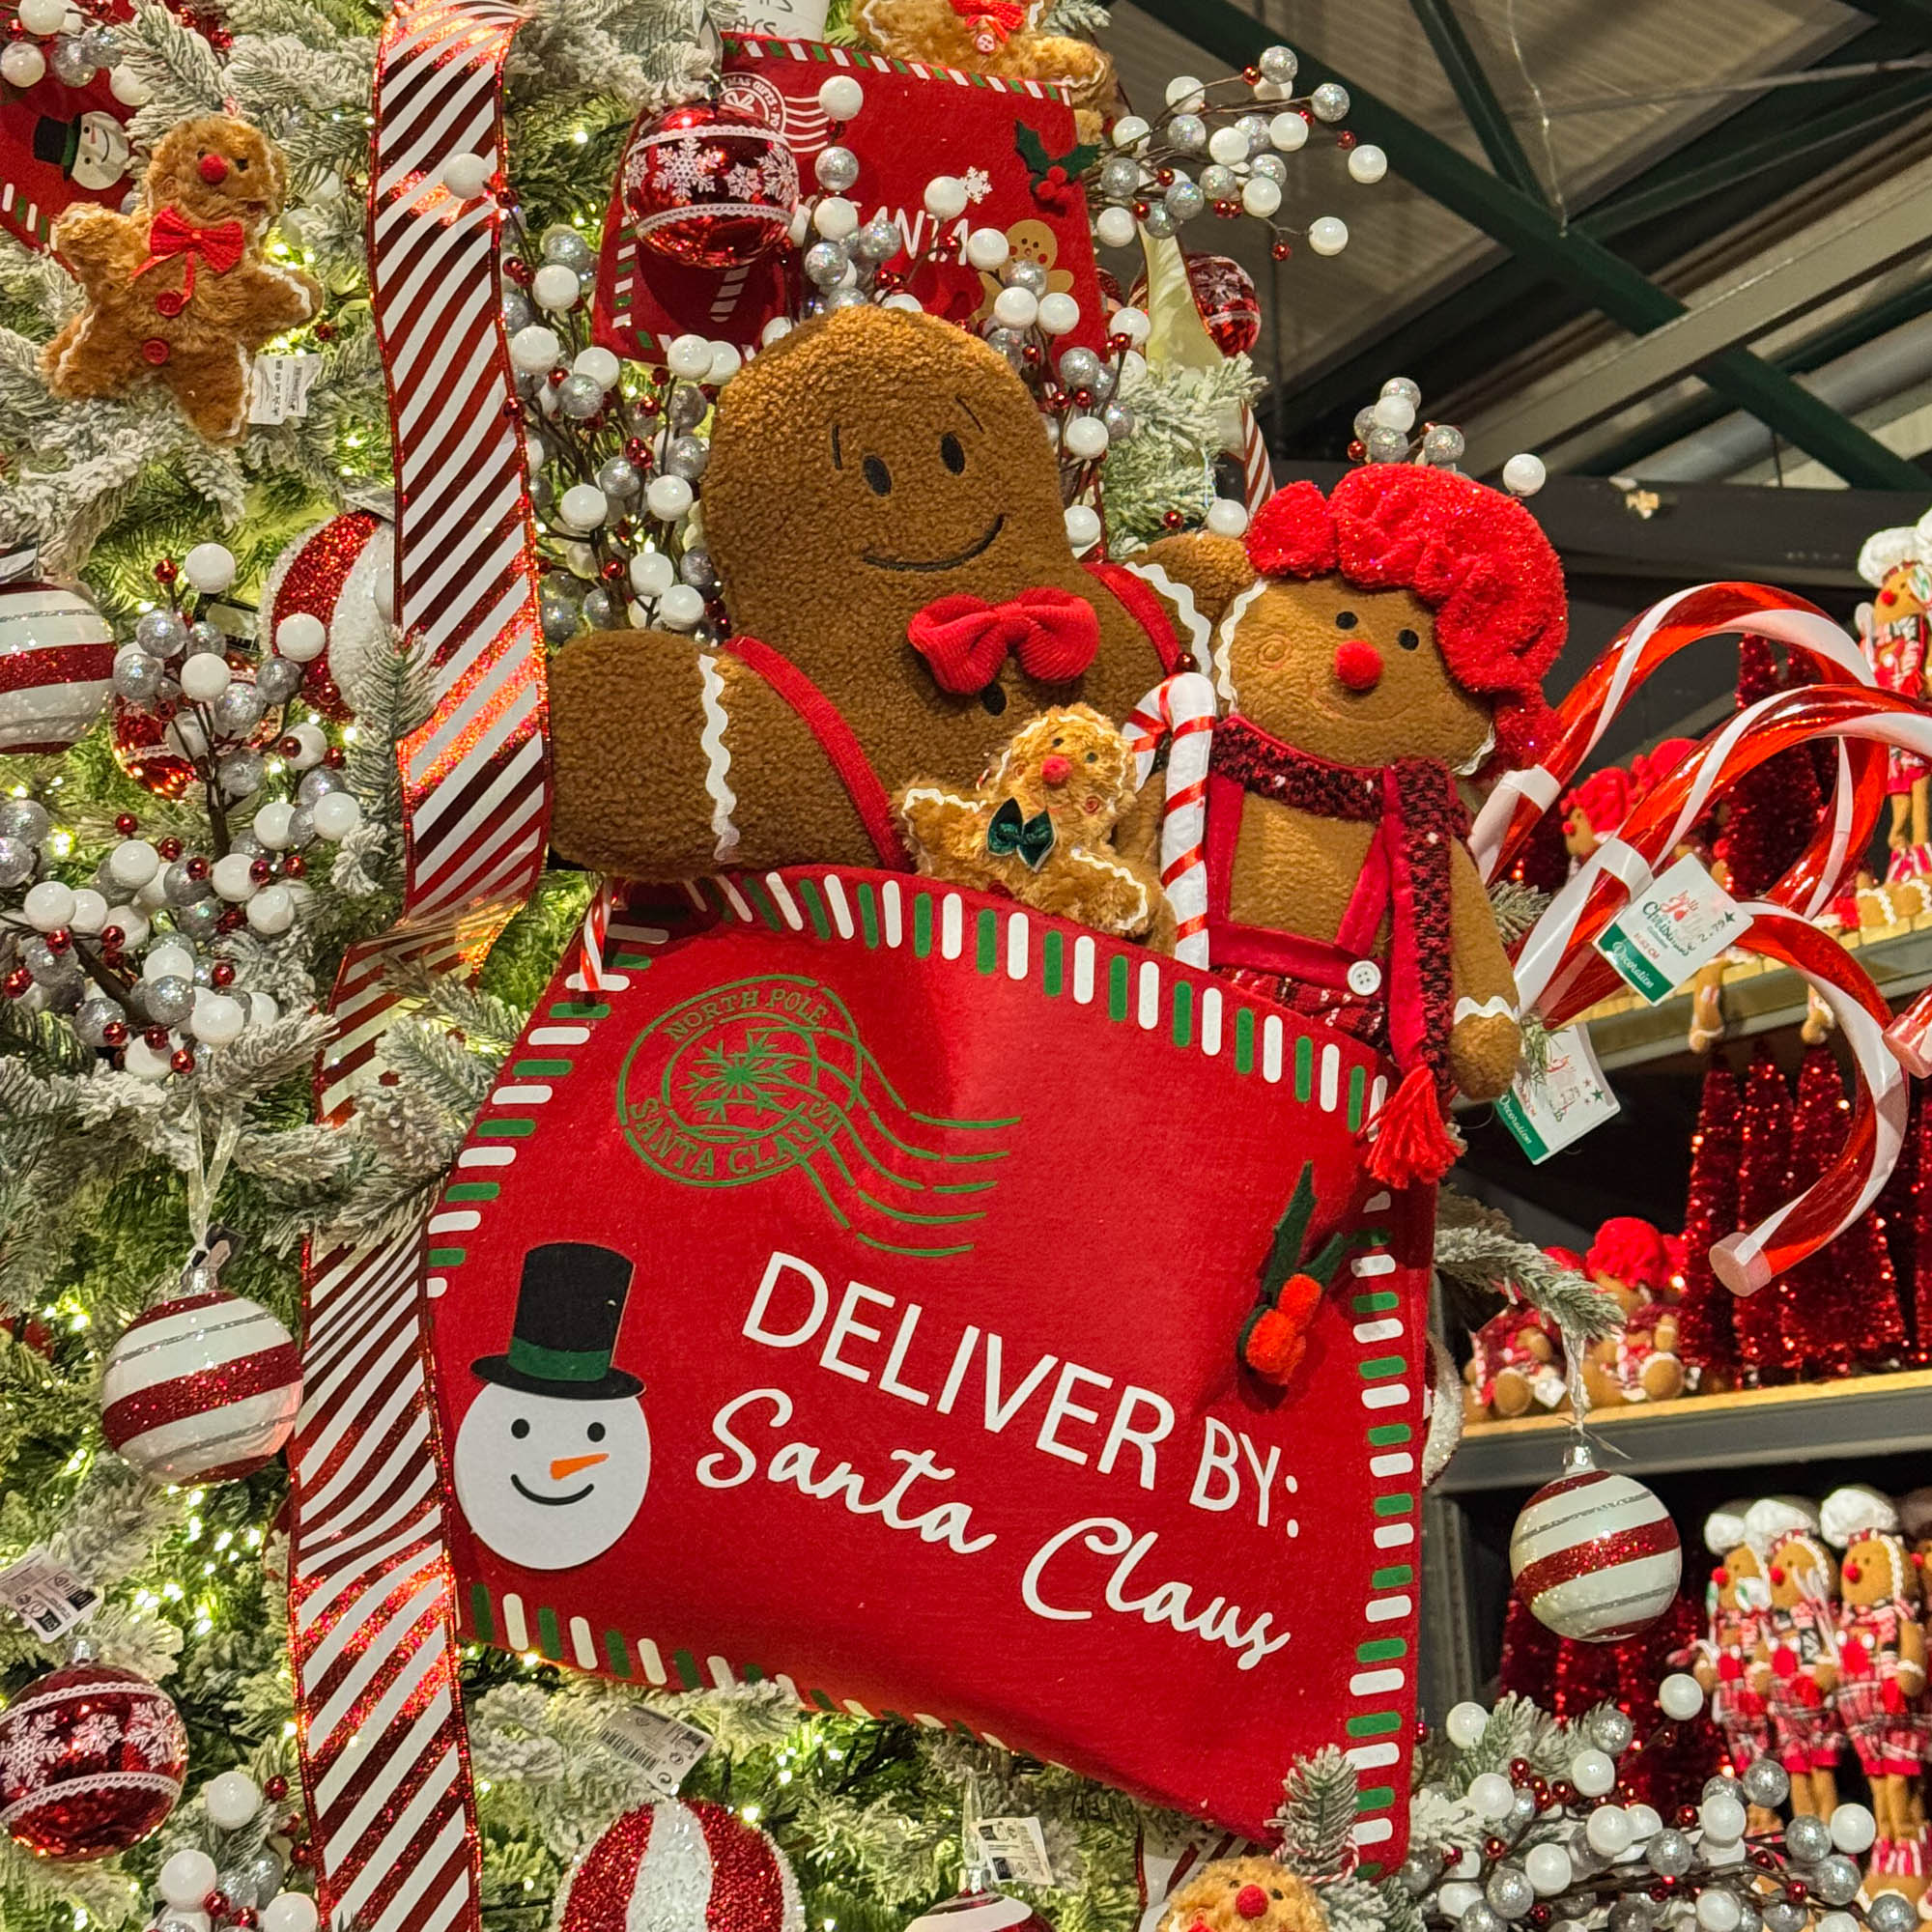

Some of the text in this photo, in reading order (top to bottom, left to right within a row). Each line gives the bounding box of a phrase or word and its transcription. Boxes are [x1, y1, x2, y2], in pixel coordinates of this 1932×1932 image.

[753, 81, 779, 106] GIFTS
[1612, 941, 1655, 989] Decoration
[663, 988, 829, 1041] NORTH POLE
[630, 1097, 838, 1177] SANTA CLAUS
[1498, 1094, 1533, 1145] Decoration
[742, 1251, 1299, 1538] DELIVER BY:
[696, 1388, 1291, 1670] Santa Claus
